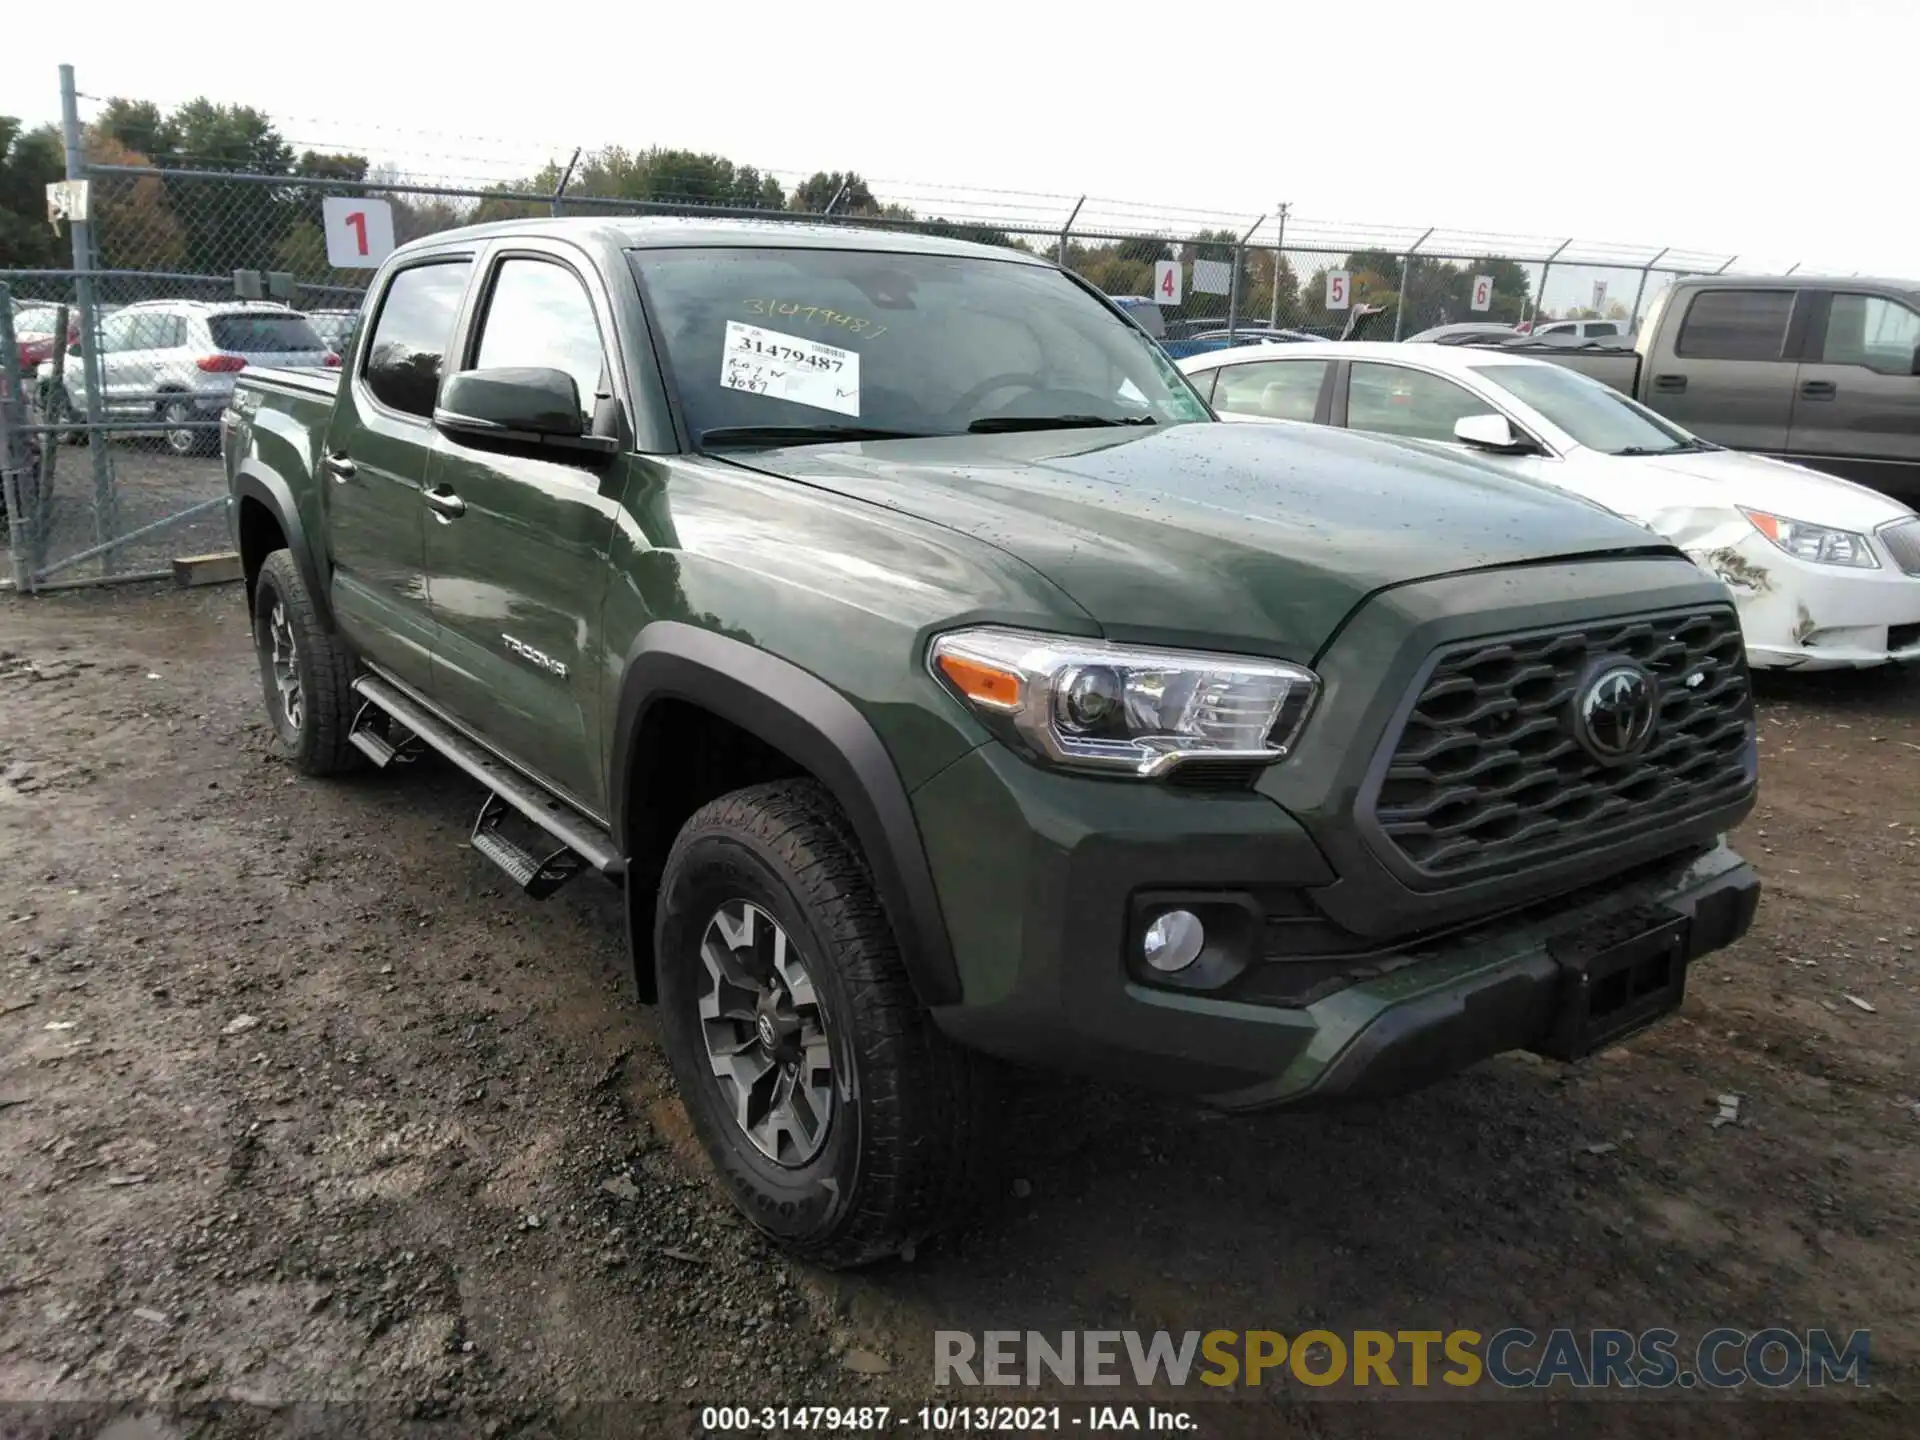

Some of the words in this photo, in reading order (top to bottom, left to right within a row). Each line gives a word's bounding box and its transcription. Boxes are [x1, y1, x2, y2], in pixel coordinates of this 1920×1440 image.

[345, 211, 368, 256] 1
[1162, 269, 1174, 297] 4
[1332, 277, 1343, 302] 5
[1477, 282, 1487, 305] 6
[739, 337, 843, 373] 31479487
